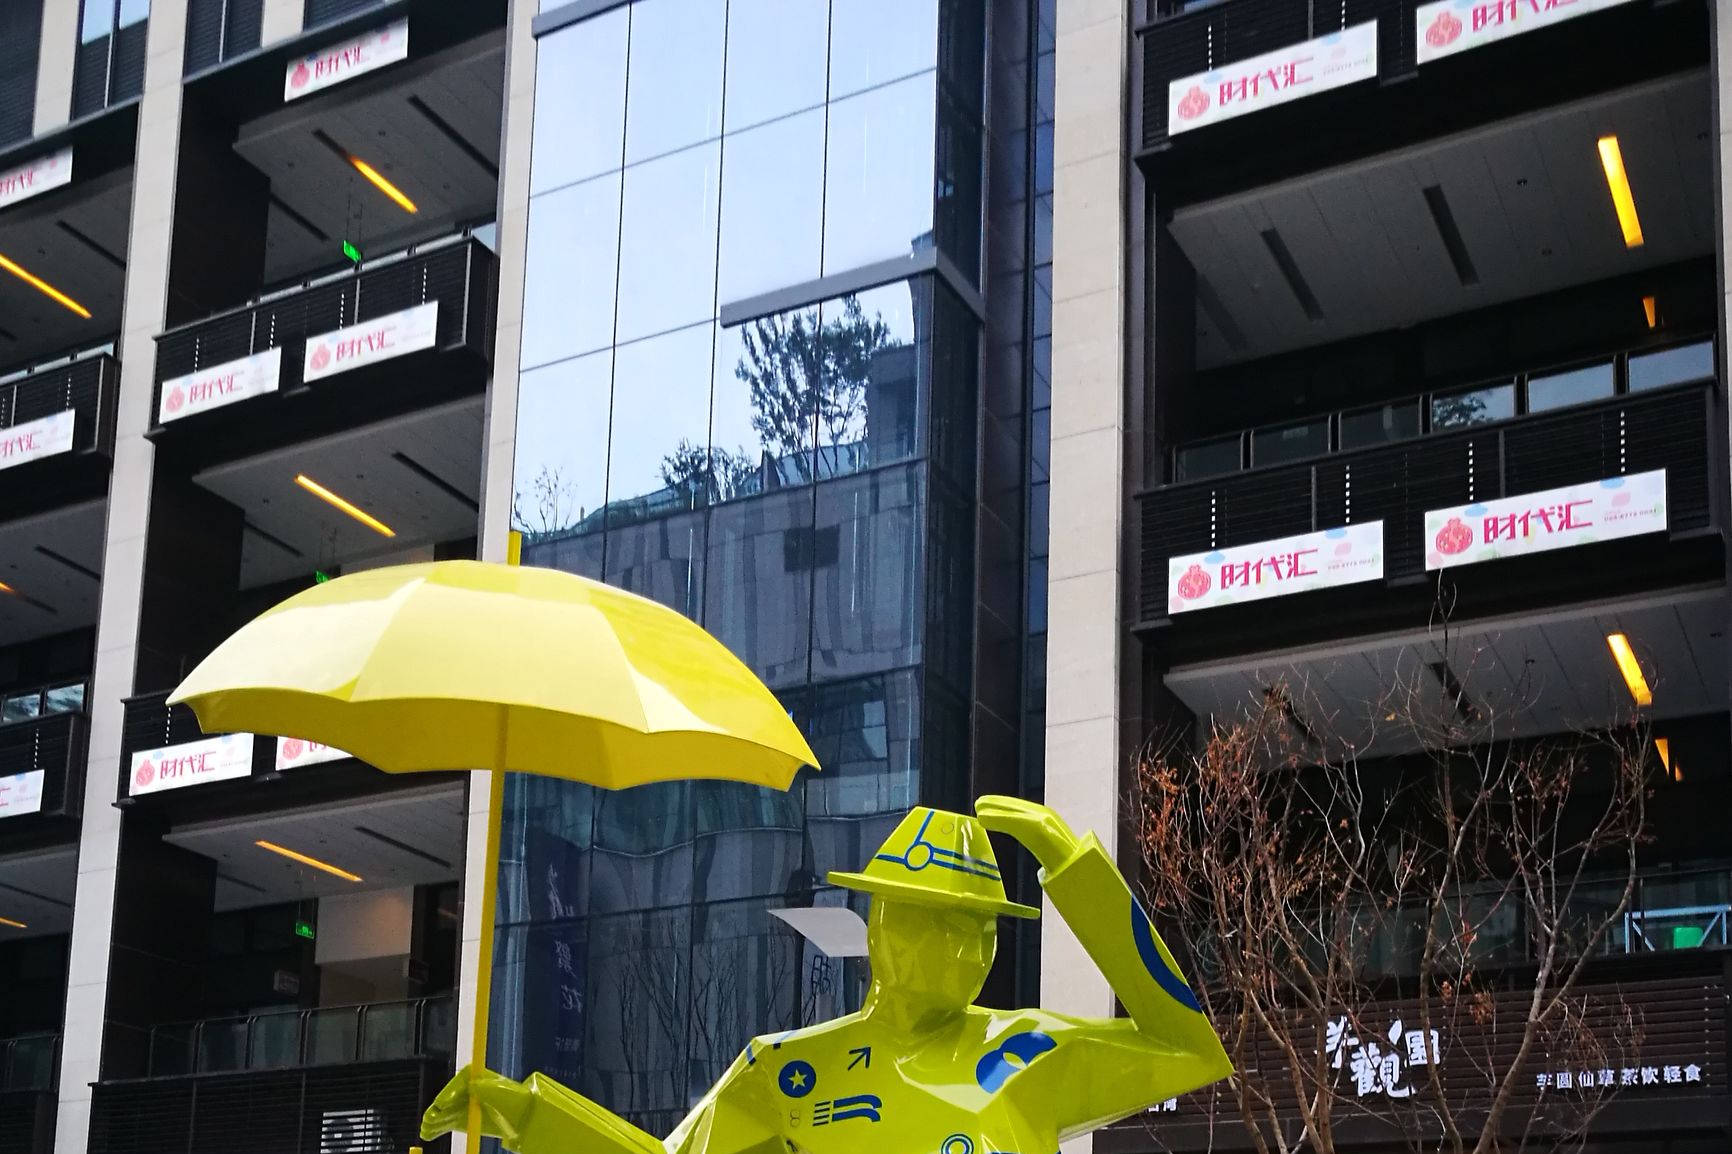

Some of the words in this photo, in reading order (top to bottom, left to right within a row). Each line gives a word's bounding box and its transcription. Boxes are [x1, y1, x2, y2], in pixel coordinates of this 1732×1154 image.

[1219, 57, 1314, 106] 时代汇
[335, 326, 397, 361] 时代汇
[189, 371, 244, 403] 时代汇
[1483, 499, 1593, 544] 时代汇
[1221, 549, 1318, 590] 时代汇
[160, 751, 216, 779] 时代汇
